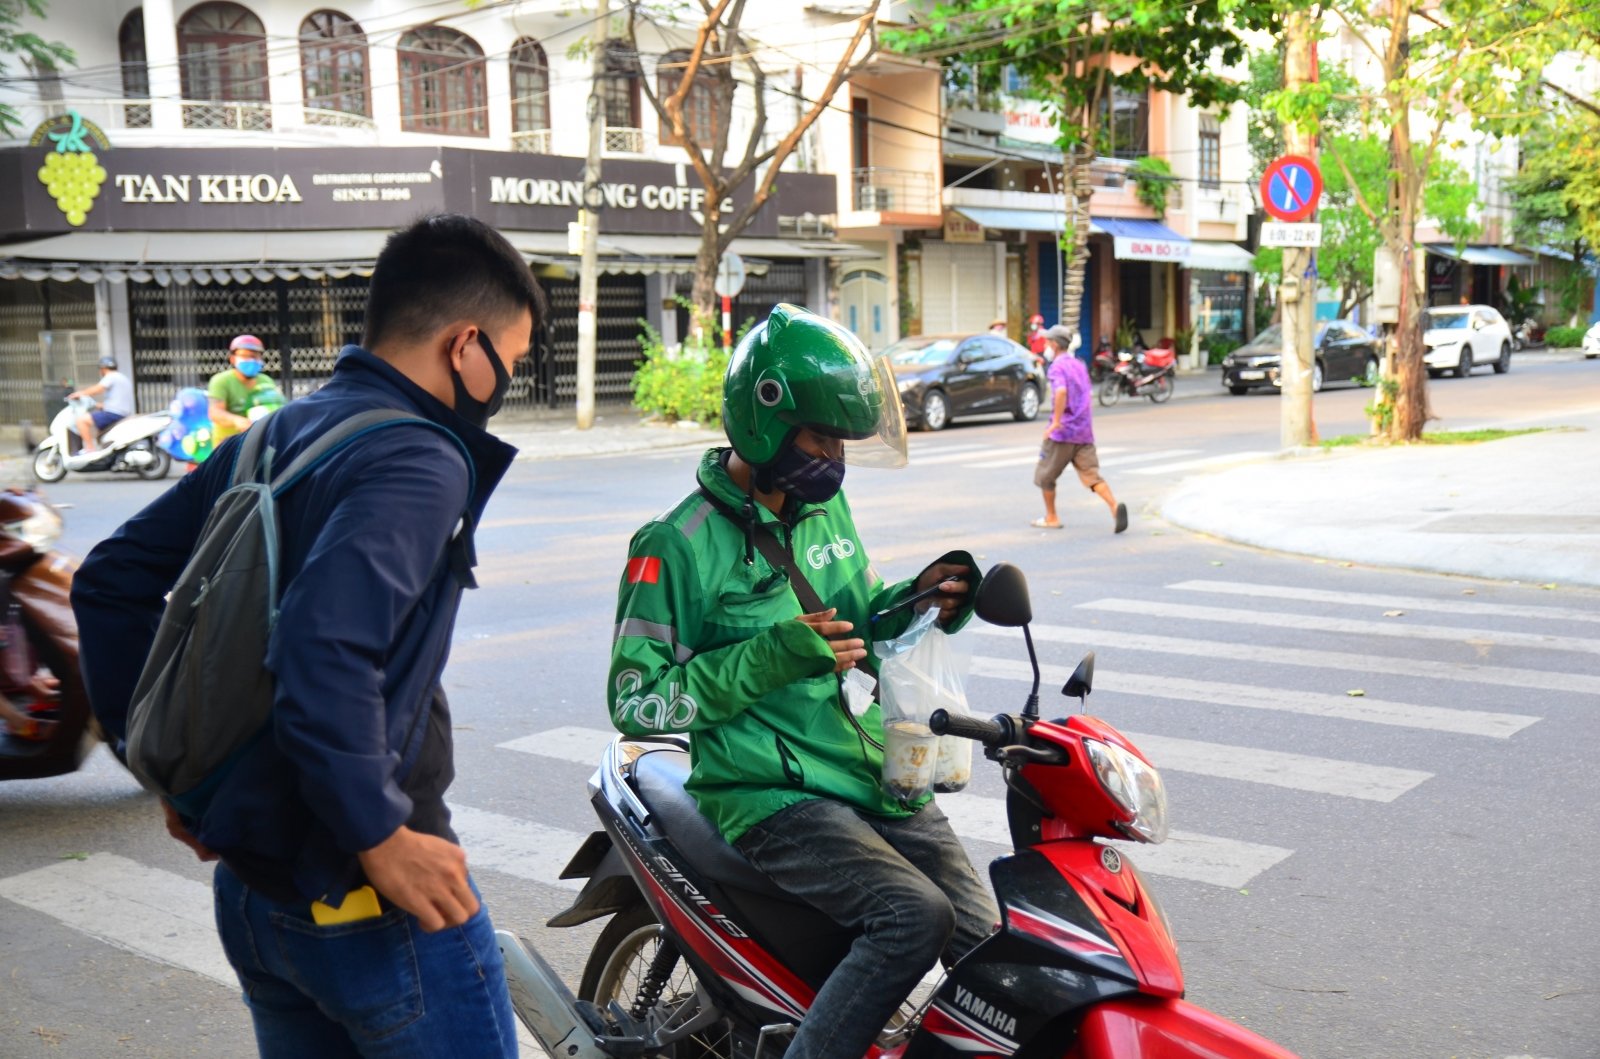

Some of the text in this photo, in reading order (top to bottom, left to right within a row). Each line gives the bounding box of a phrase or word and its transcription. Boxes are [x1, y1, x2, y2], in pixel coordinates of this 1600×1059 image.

[115, 174, 303, 202] TAN KHOA
[332, 188, 379, 201] SINCE
[489, 176, 734, 213] MORNNG COFFE
[806, 534, 856, 570] Grab
[652, 854, 749, 938] SIRIUS
[954, 984, 1017, 1037] YAMAHA
